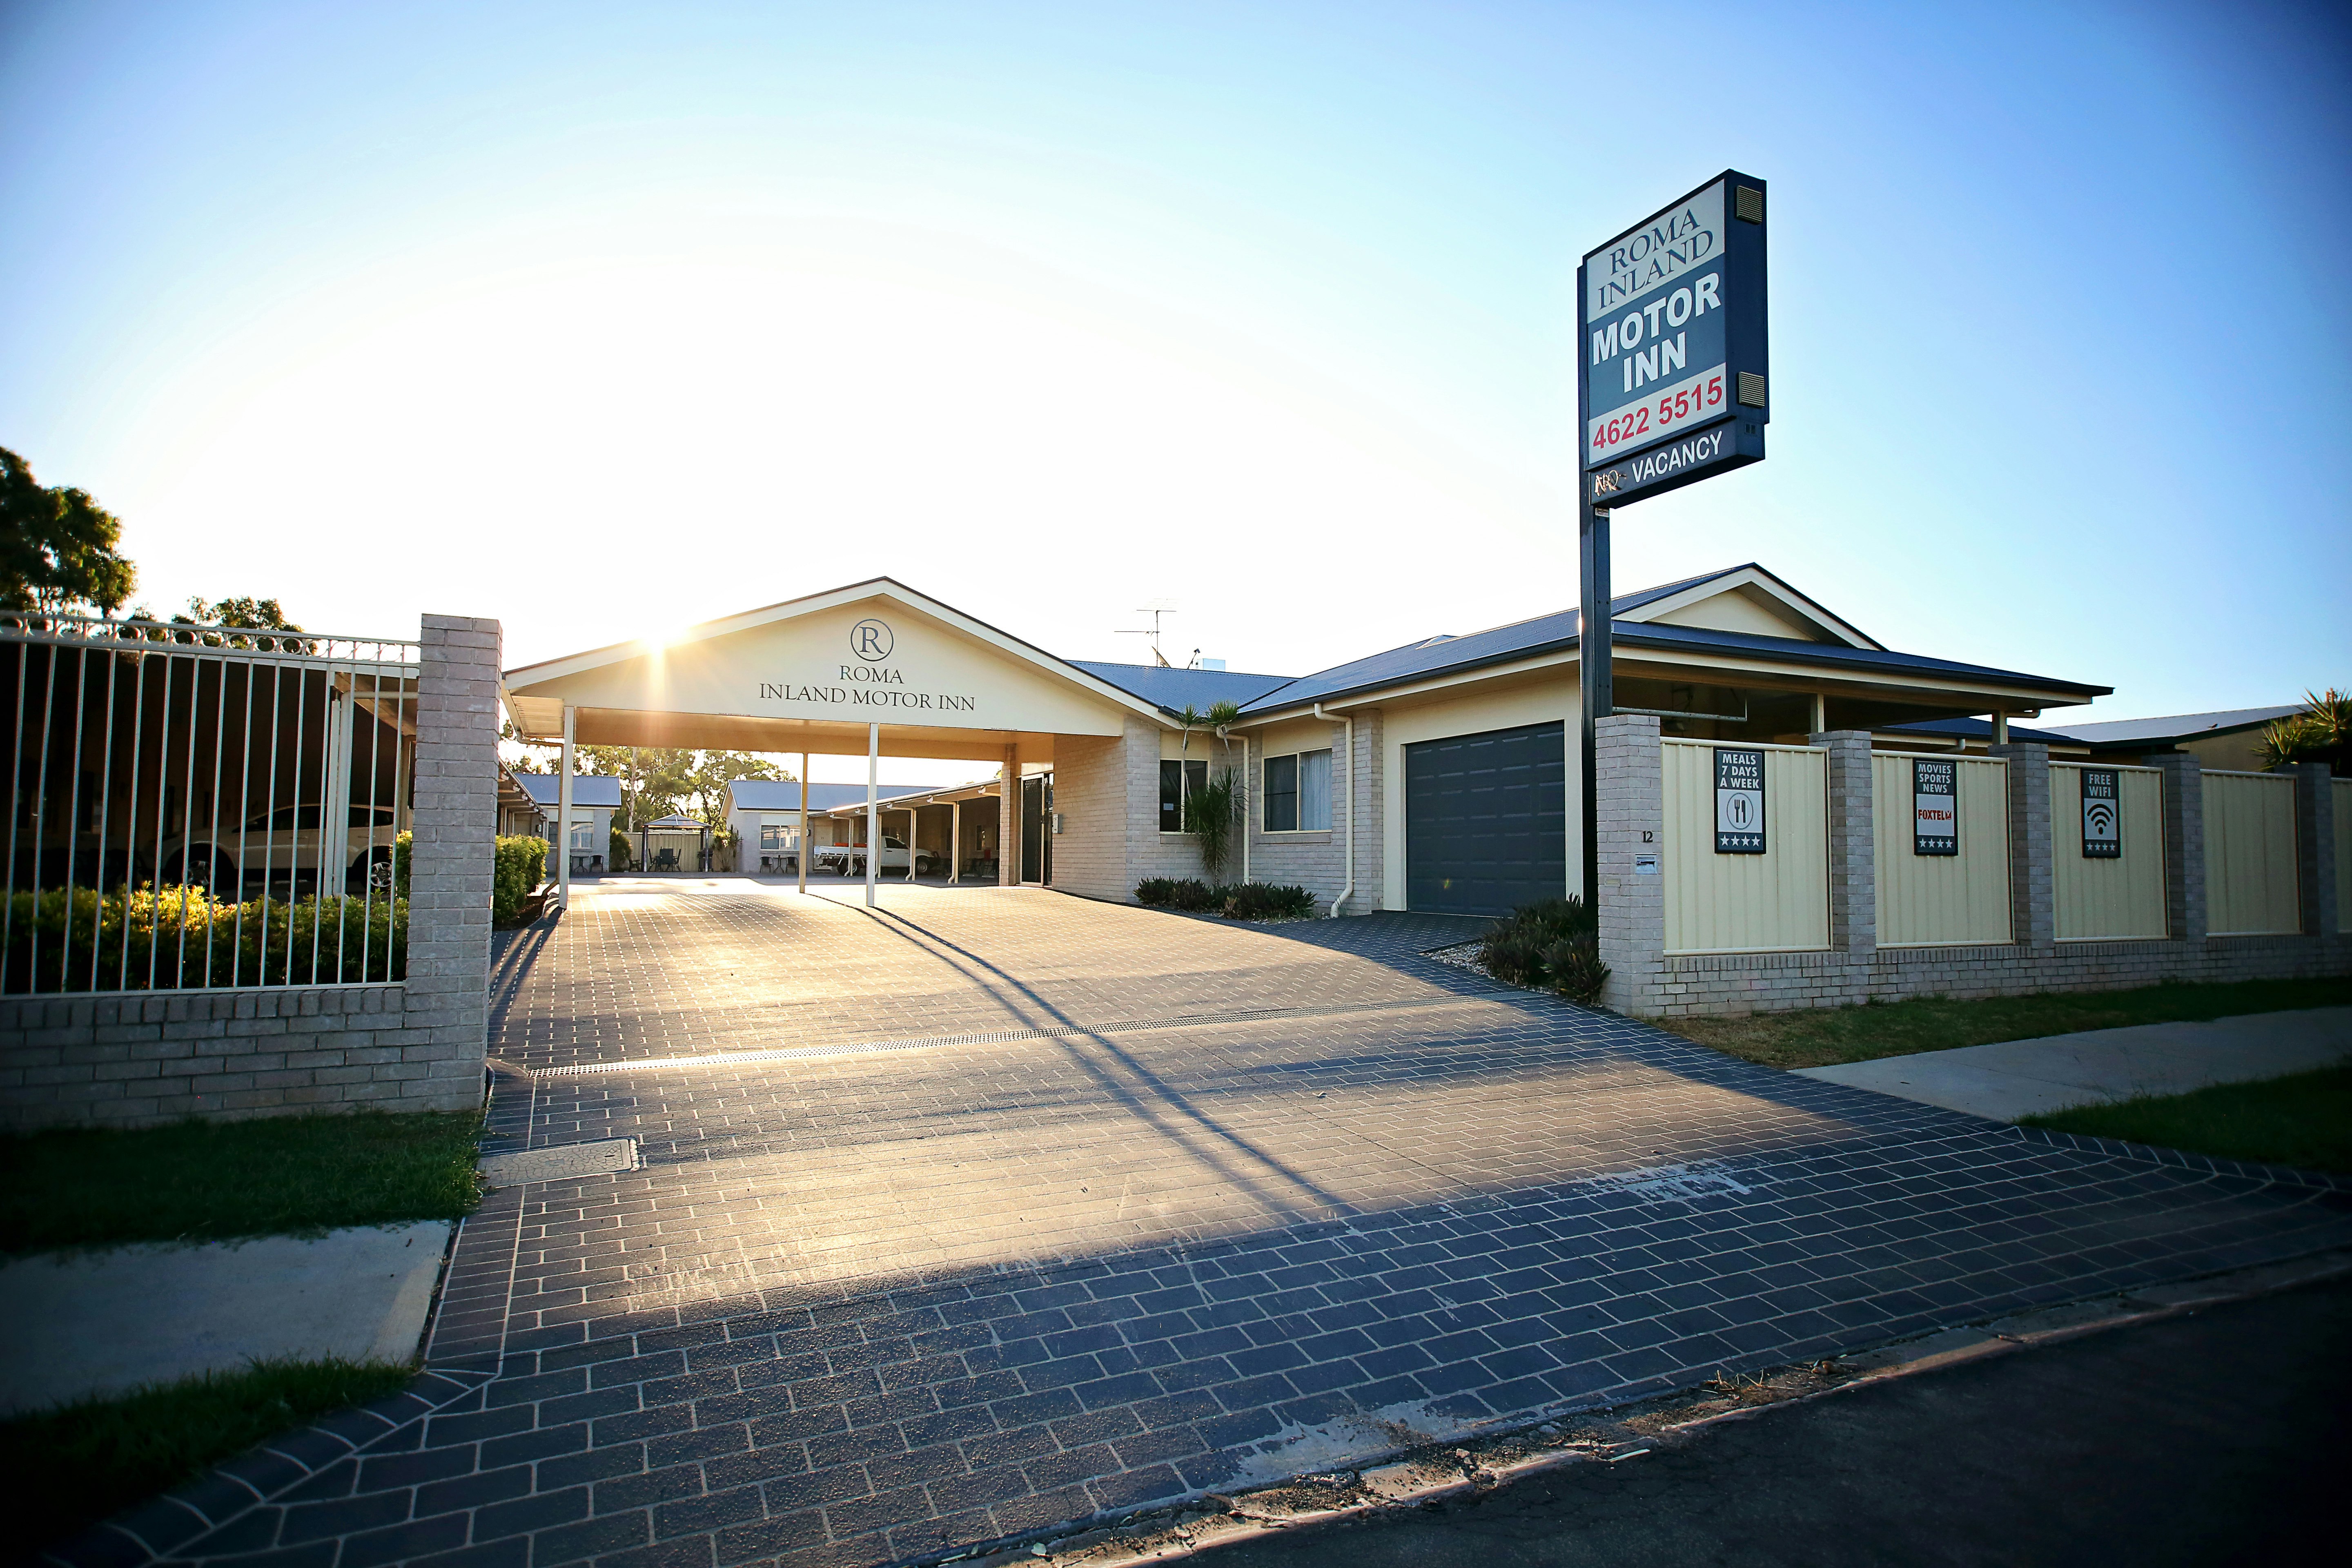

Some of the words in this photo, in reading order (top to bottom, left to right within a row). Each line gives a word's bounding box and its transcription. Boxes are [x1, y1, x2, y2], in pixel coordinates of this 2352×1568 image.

[1609, 209, 1701, 276] ROMA
[1598, 230, 1714, 310] INLAND
[1593, 272, 1722, 366] MOTOR
[1624, 331, 1686, 393] INN
[1594, 407, 1649, 448] 4622
[1659, 376, 1722, 424] 5515
[1632, 430, 1722, 483] VACANCY
[859, 626, 885, 654] R
[840, 665, 904, 684] ROMA
[760, 683, 846, 703] INLAND
[852, 689, 933, 708] MOTOR
[938, 695, 975, 711] INN
[1722, 754, 1756, 765] MEALS
[1722, 765, 1728, 775] 7
[1732, 766, 1757, 777] DAYS
[1918, 764, 1951, 774] MOVIES
[1720, 777, 1728, 787] A
[1731, 778, 1759, 788] WEEK
[1919, 774, 1950, 784] SPORTS
[2089, 774, 2111, 785] FREE
[1923, 784, 1947, 793] NEWS
[2089, 786, 2111, 797] WIFI
[1918, 809, 1945, 820] FOXTEL
[1643, 831, 1653, 843] 12
